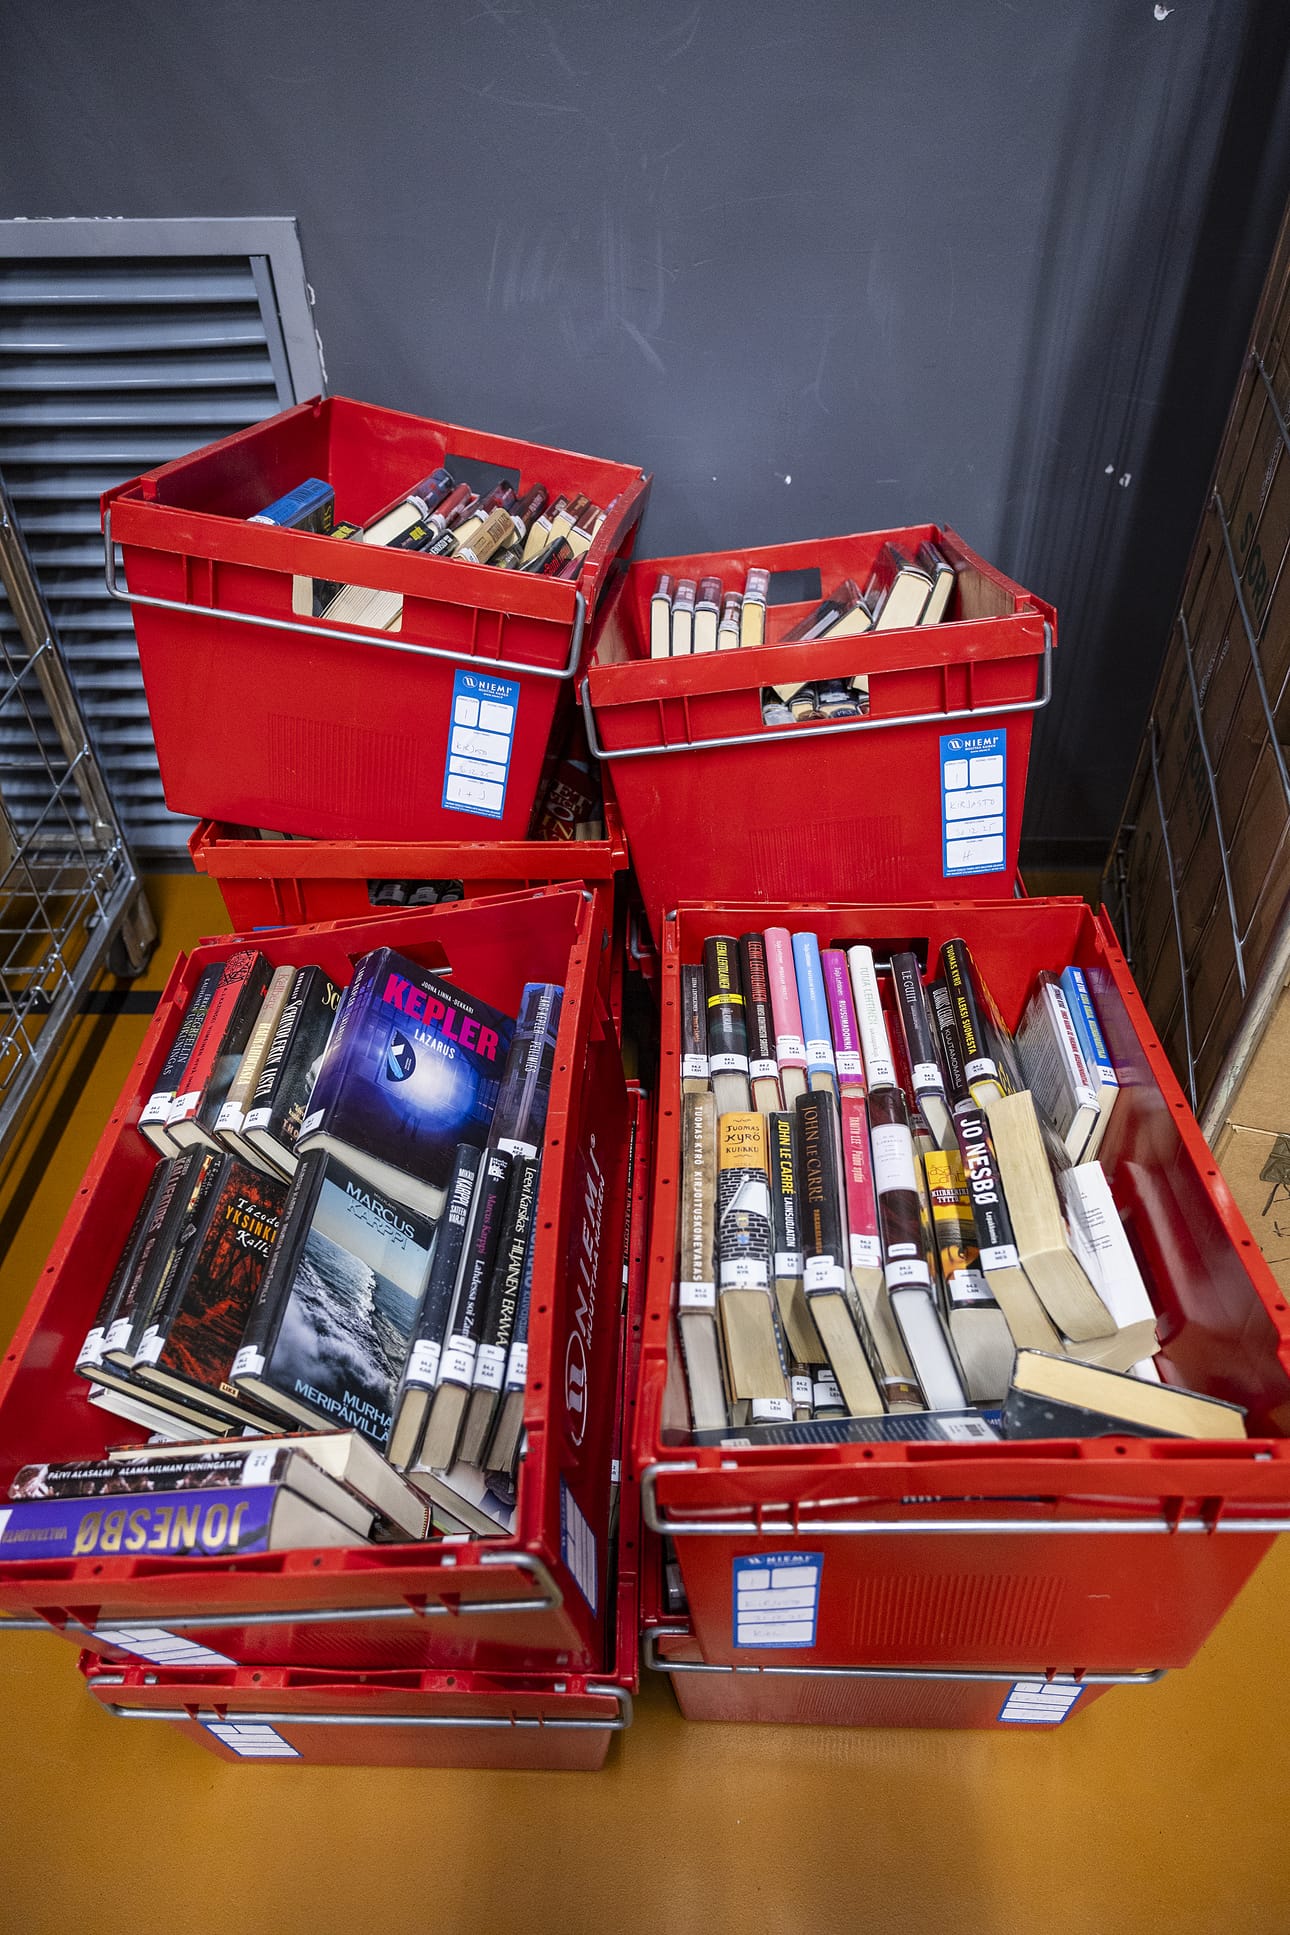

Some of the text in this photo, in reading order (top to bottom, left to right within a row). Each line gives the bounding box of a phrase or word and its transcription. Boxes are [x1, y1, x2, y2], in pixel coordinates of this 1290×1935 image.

[478, 681, 510, 695] NIEMI
[964, 737, 996, 748] NIEMI
[716, 940, 727, 956] LEENA
[747, 940, 762, 960] LEENA
[716, 956, 730, 989] LEHTOLAINEN
[746, 959, 769, 1003] LEHTOLAINEN
[382, 973, 499, 1062] KEPLER
[862, 988, 879, 1025] LEHTINEN
[944, 945, 977, 1053] TUOMAS KYRÖ ALEKSI SUOMESTA
[265, 999, 301, 1066] SCHINDLERIN
[524, 995, 550, 1072] LARS KEPLER PEILIMIES
[835, 1000, 854, 1049] RUUSUMADONNA
[162, 1013, 193, 1075] UNIKUNINGAS
[413, 1028, 457, 1060] LAZARUS
[941, 1030, 965, 1086] KUUTAMOMAILI
[253, 1066, 277, 1101] LISTA
[724, 1131, 761, 1145] KYRÖ
[800, 1104, 820, 1141] JOHN
[847, 1115, 861, 1135] TANITH
[849, 1134, 861, 1145] LEE
[957, 1115, 983, 1140] JO
[805, 1143, 818, 1156] LE
[451, 1177, 473, 1207] KARPPI
[692, 1105, 703, 1281] TUOMAS KYRÖ KIRJOITUSKONEVARAS
[776, 1119, 796, 1247] JOHN LE CARRÉ LAINSUOJATON
[803, 1156, 826, 1203] CARRÉ
[961, 1141, 999, 1208] NESBØ
[149, 1157, 185, 1232] KALLIFATIDES
[346, 1180, 416, 1239] MARCUS
[482, 1194, 496, 1222] Marcus
[346, 1200, 408, 1251] KARPPI
[474, 1225, 490, 1253] Karppi
[502, 1167, 536, 1293] Leevi Karsikas HILJAINEN
[574, 1146, 601, 1337] NIEMI
[468, 1260, 484, 1299] Lahdessa
[464, 1300, 476, 1315] soi
[293, 1378, 392, 1442] MERIPÄIVILLÄ
[343, 1389, 393, 1427] MURHA
[47, 1469, 71, 1481] PÄIVI
[70, 1467, 115, 1480] ALASALMI
[117, 1463, 184, 1477] ALAMAAILMAN
[183, 1459, 243, 1474] KUNINGATAR
